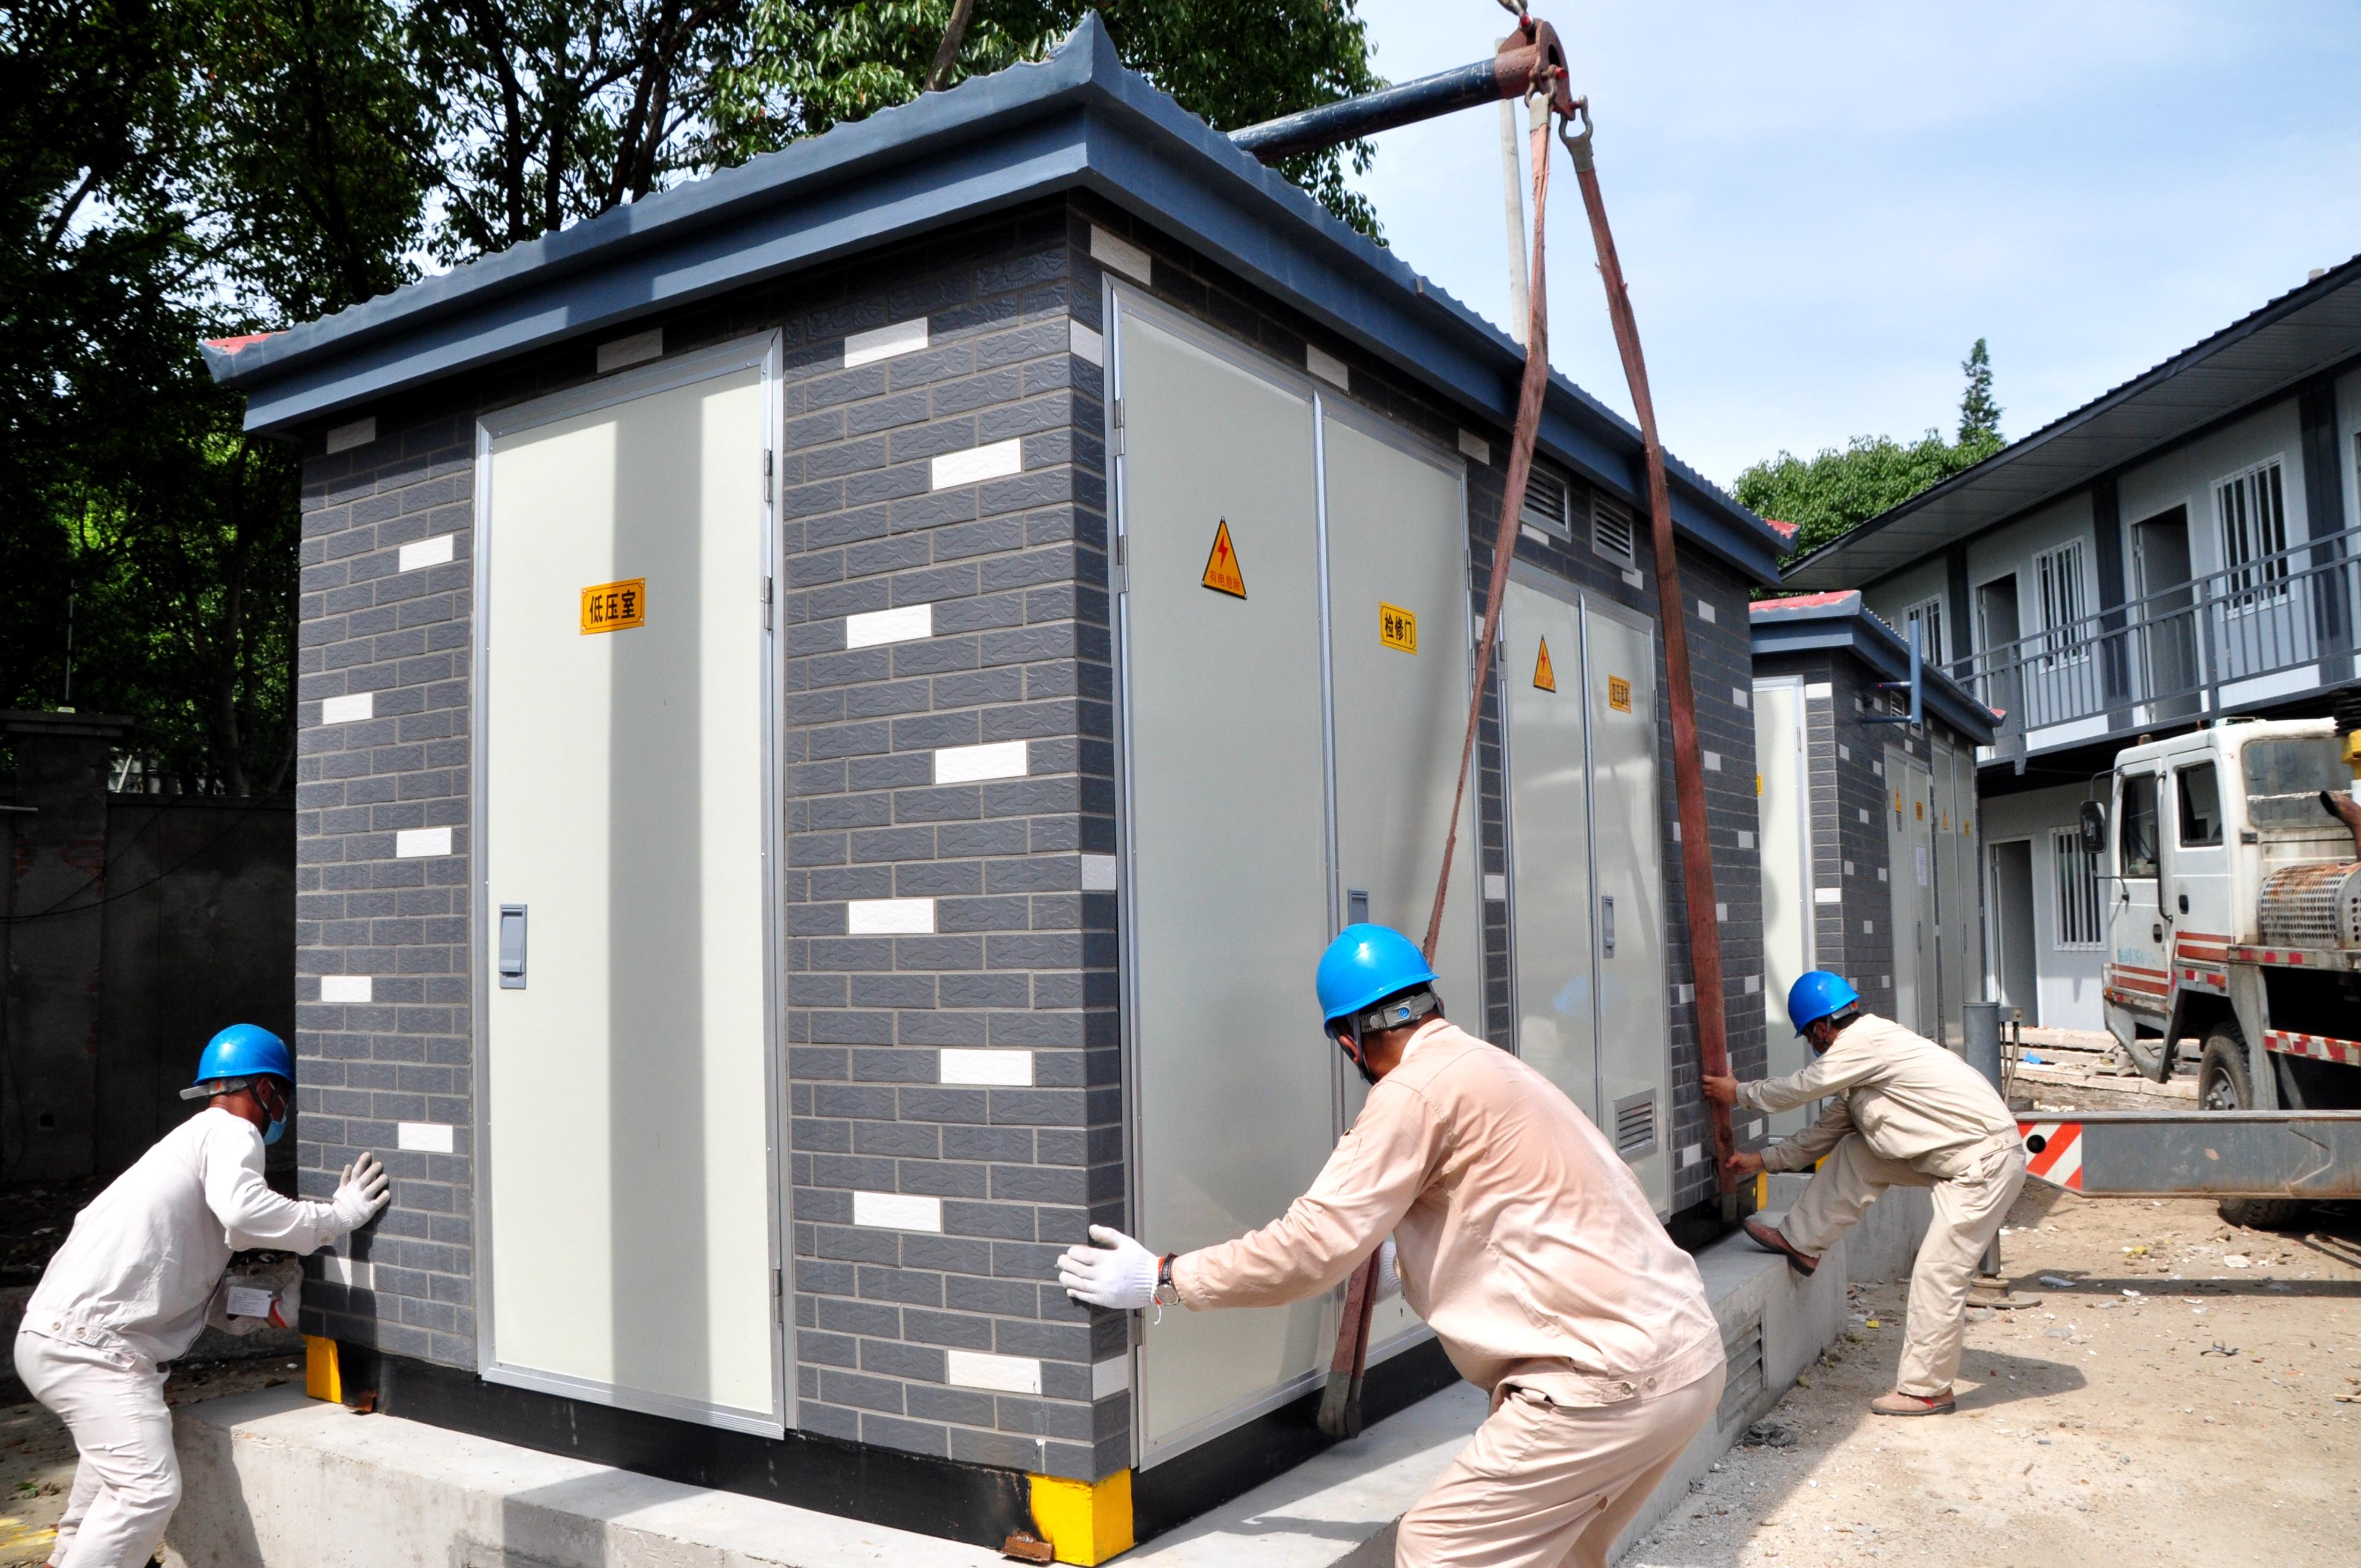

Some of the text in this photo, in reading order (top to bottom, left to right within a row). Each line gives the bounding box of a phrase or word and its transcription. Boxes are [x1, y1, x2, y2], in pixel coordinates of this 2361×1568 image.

[1209, 570, 1241, 591] 有电危险
[590, 589, 635, 624] 低压室
[1385, 613, 1412, 645] 检修门
